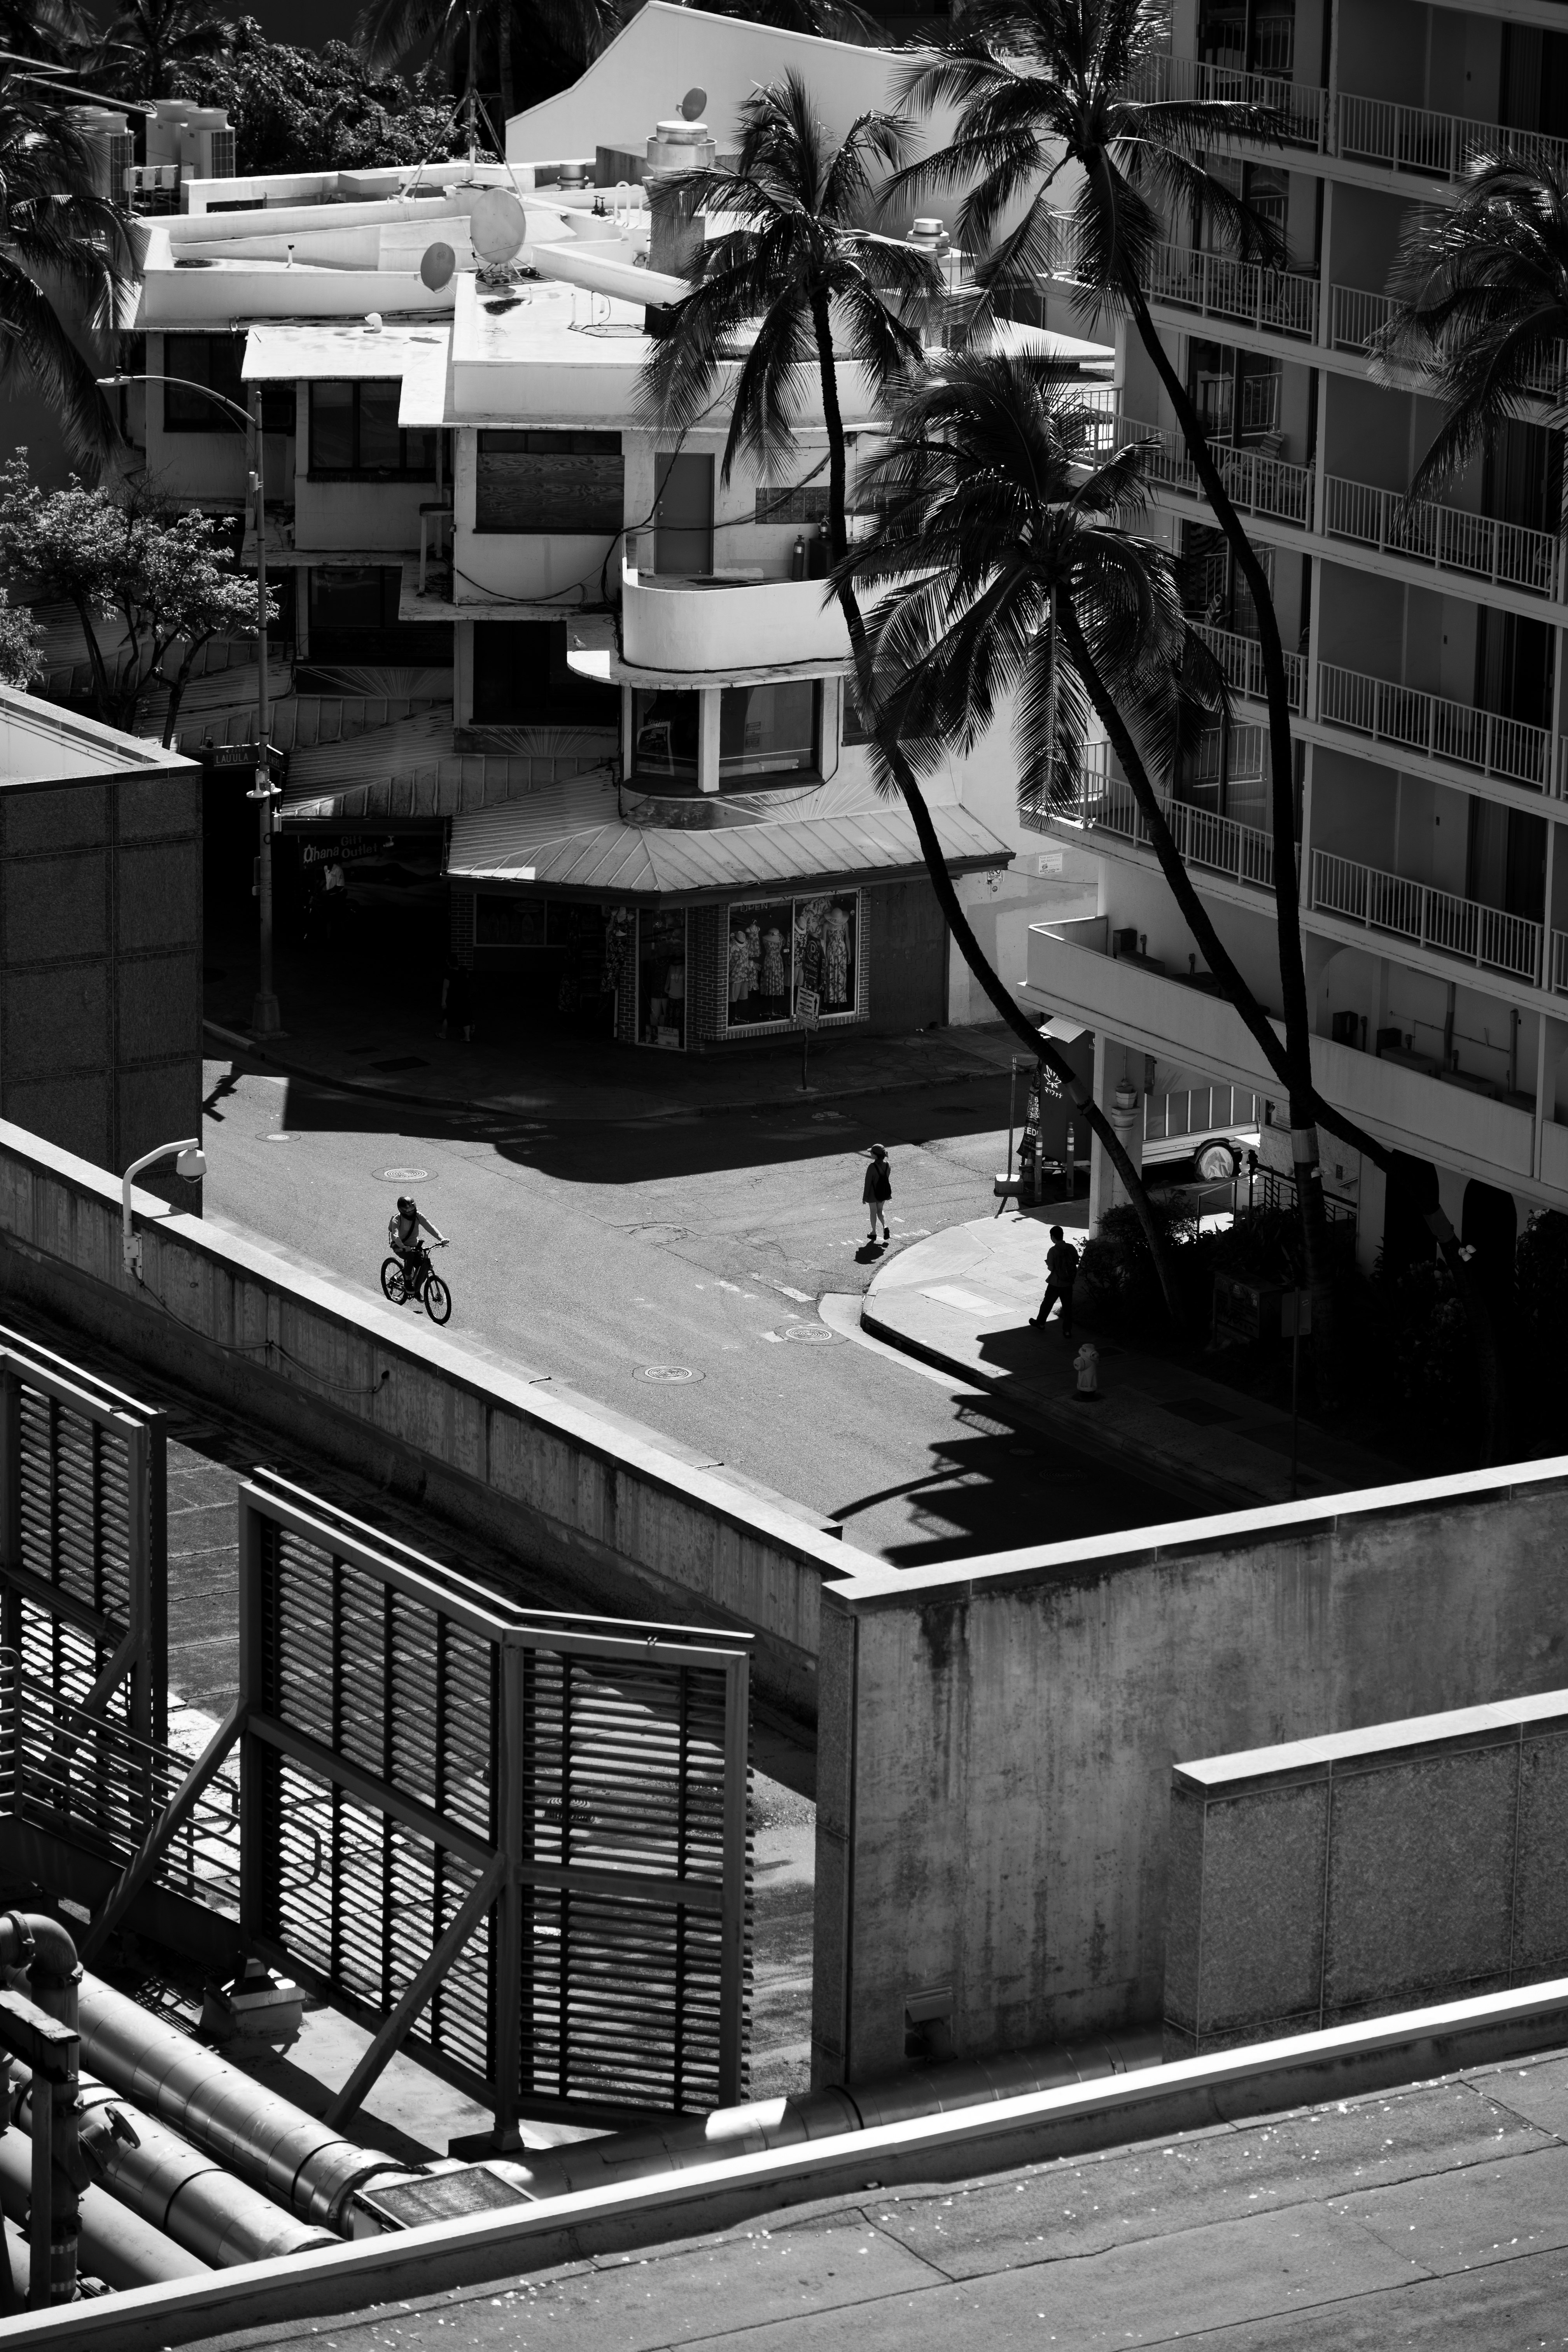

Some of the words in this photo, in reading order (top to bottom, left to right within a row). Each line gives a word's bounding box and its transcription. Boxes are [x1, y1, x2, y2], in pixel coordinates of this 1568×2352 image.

[341, 843, 378, 858] Outlet
[740, 902, 768, 912] OPEN
[805, 963, 817, 972] PARKING
